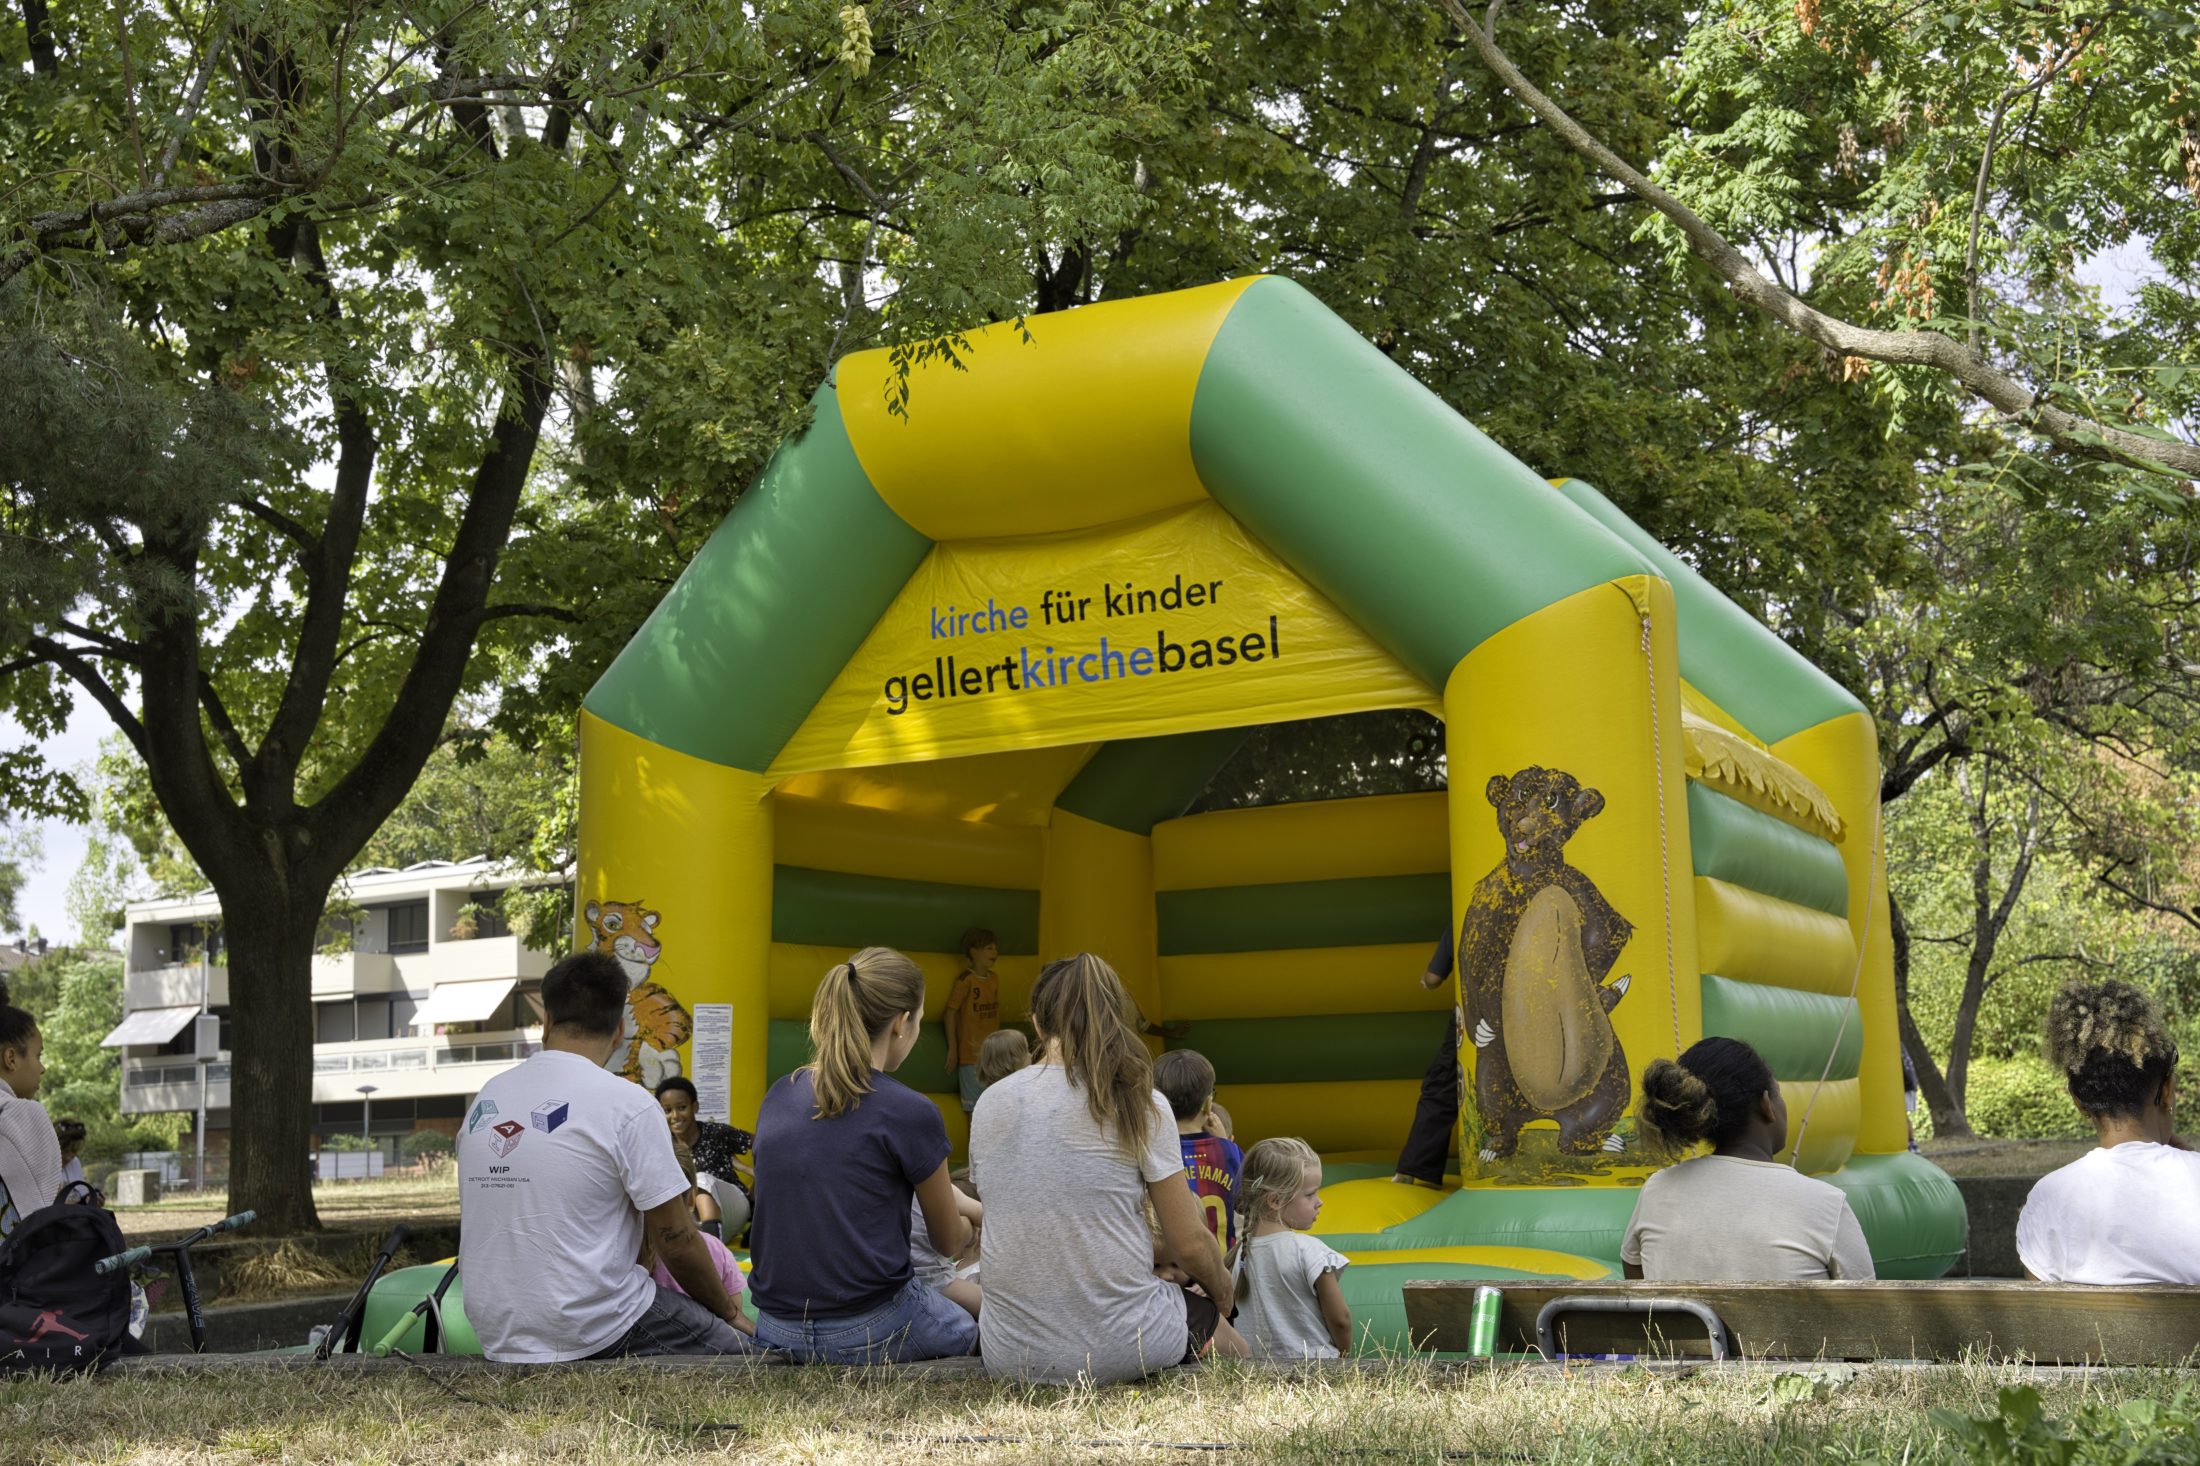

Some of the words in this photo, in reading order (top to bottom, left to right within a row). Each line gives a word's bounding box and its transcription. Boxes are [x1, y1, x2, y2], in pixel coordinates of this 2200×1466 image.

[929, 597, 1029, 641] kirche
[1039, 590, 1092, 626] für
[1103, 574, 1224, 619] kinder
[883, 615, 1281, 716] gellertkirchebasel
[500, 1124, 516, 1134] A
[489, 1165, 511, 1174] WIP
[1198, 1165, 1234, 1192] YAMAL
